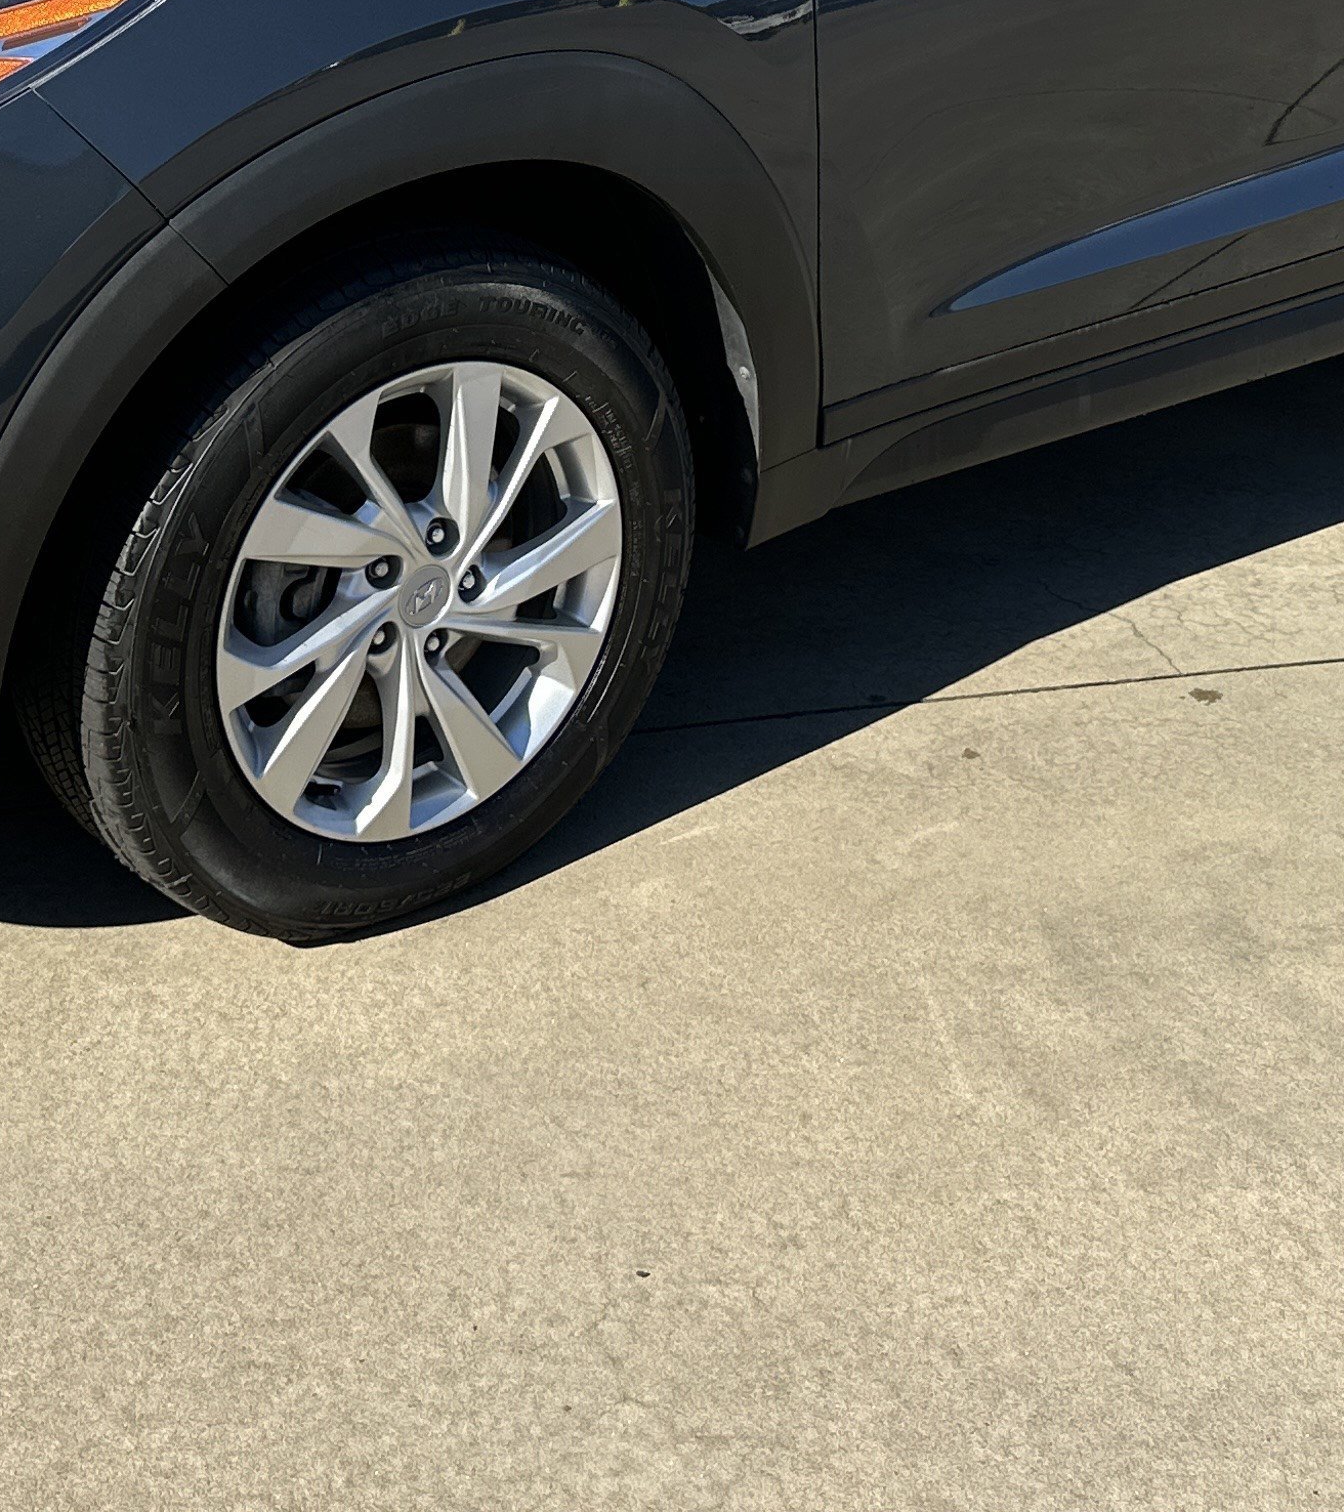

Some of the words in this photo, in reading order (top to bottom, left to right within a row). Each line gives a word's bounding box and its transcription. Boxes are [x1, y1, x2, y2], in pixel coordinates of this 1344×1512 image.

[380, 294, 466, 338] EDGE
[478, 295, 586, 337] TOURING
[147, 510, 212, 731] KELLY
